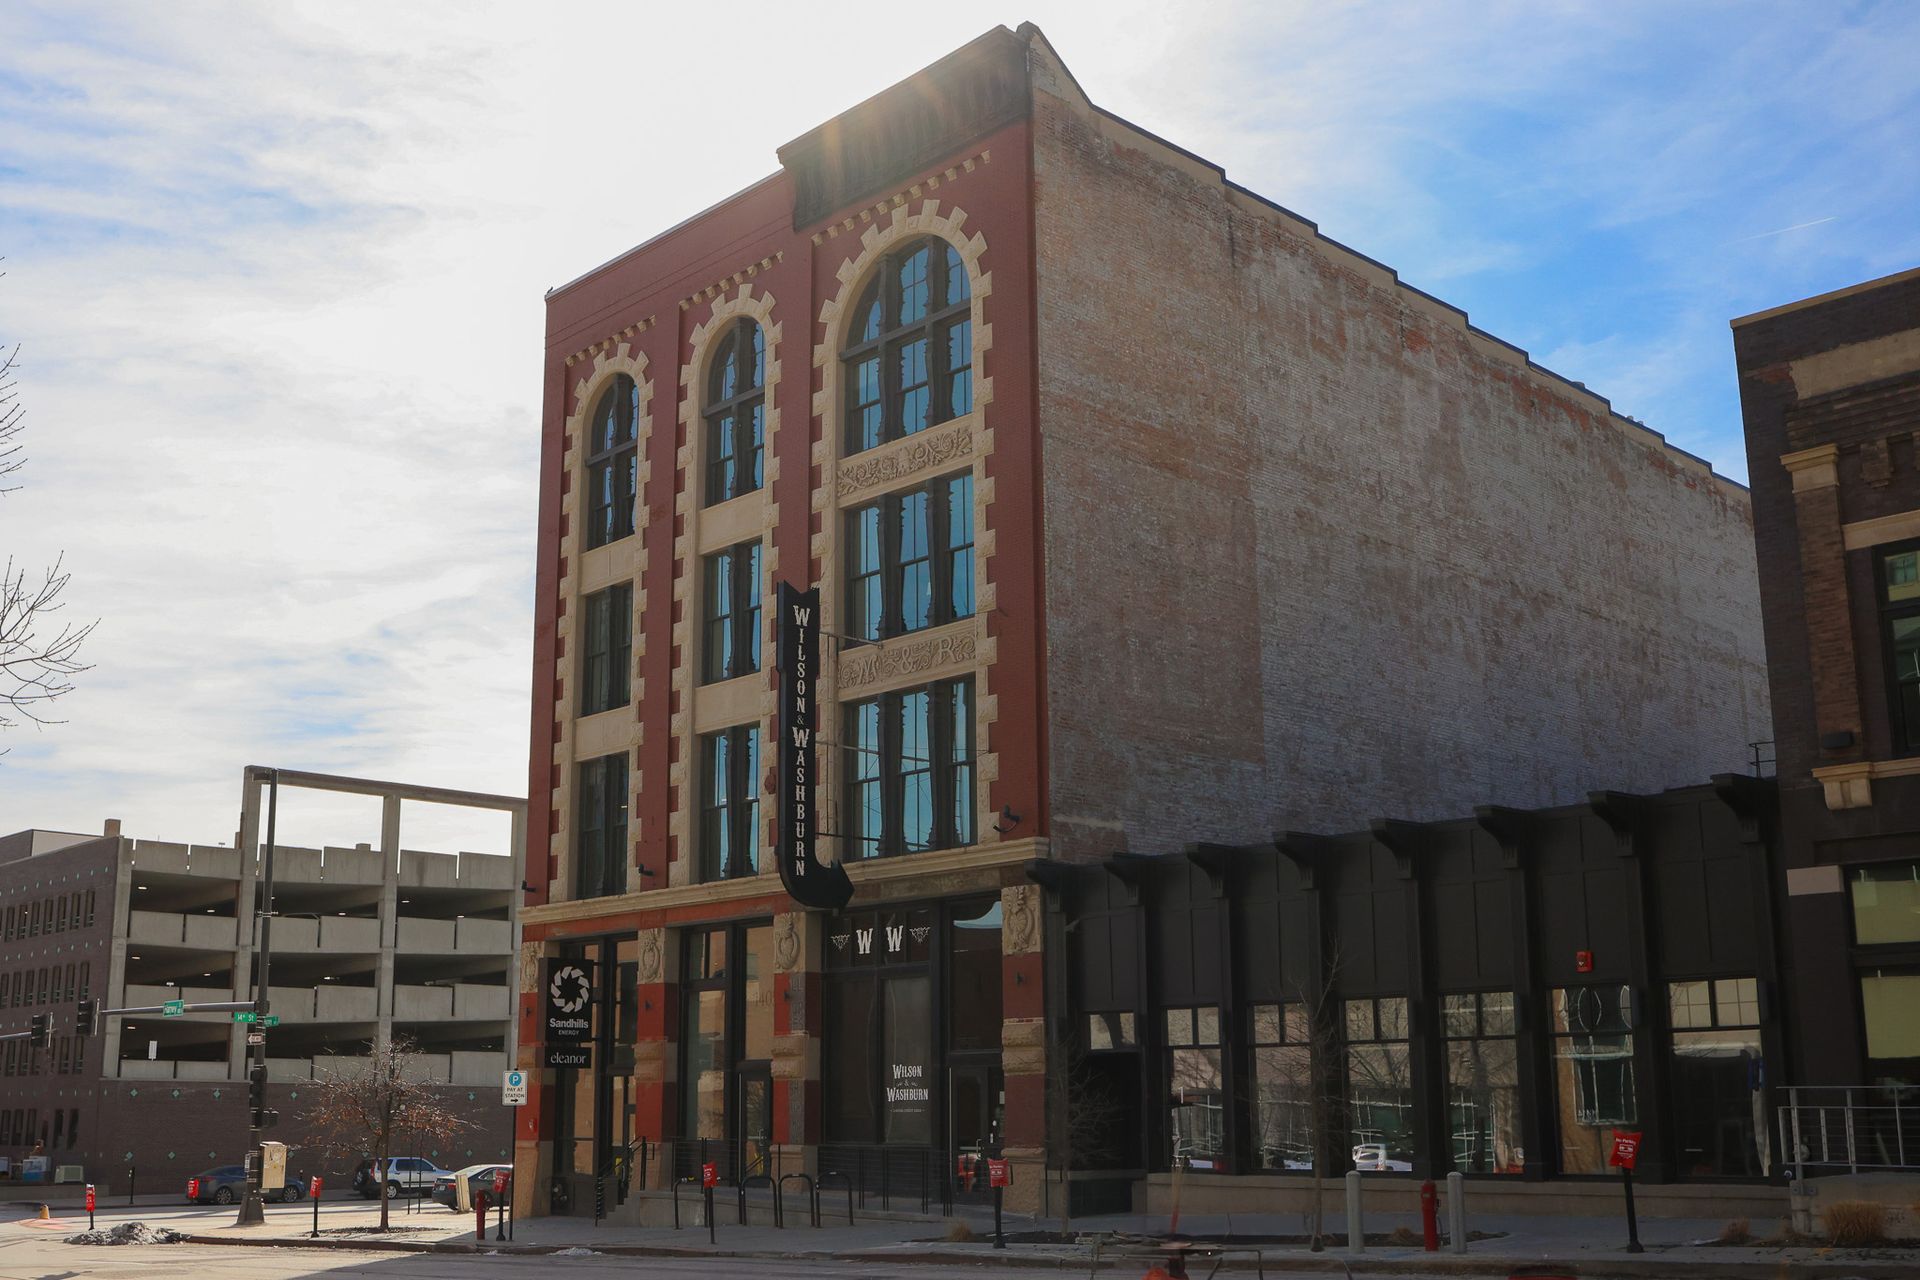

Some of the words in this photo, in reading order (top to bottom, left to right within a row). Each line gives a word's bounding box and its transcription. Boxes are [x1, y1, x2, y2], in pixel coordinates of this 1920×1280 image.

[793, 605, 810, 713] WILSON
[792, 726, 810, 876] WASHBURN
[856, 928, 874, 954] W
[885, 925, 904, 952] W
[550, 1018, 589, 1029] Sandhills
[550, 1052, 587, 1063] eleanor
[892, 1064, 922, 1079] WILSON
[886, 1087, 929, 1102] WASHBURN
